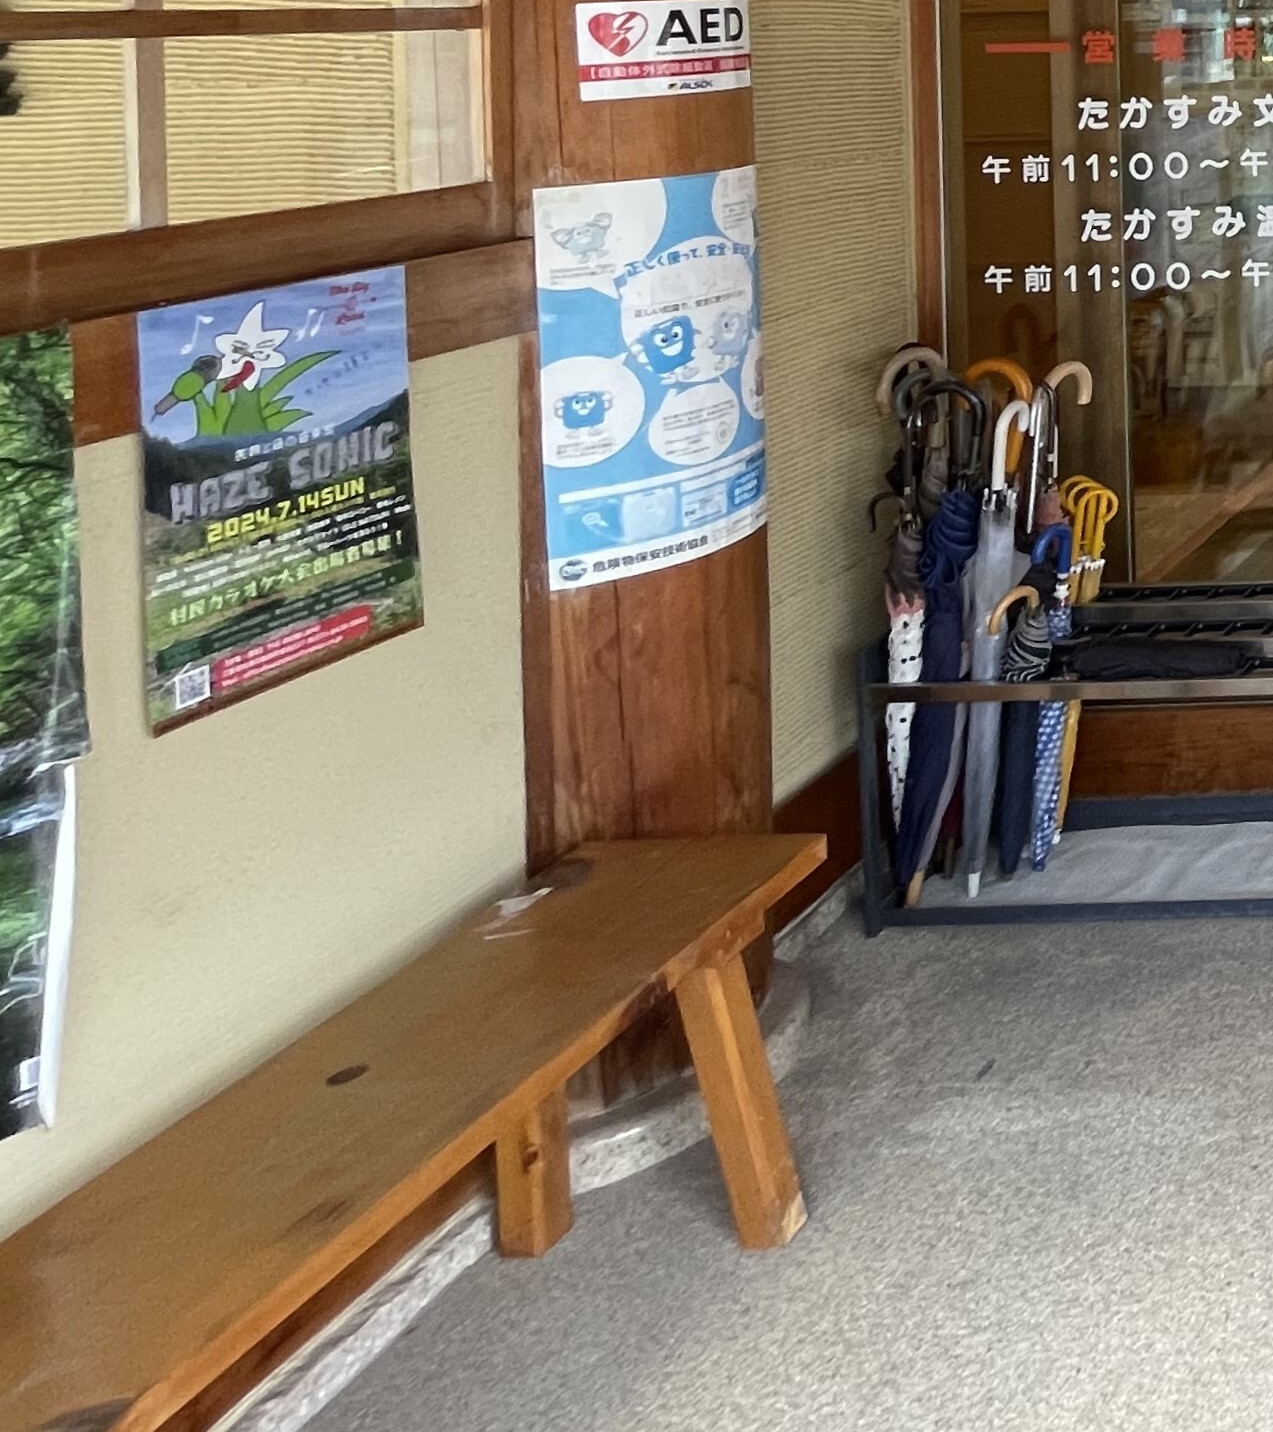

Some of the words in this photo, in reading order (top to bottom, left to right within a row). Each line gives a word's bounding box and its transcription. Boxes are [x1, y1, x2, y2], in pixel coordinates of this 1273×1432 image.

[656, 7, 743, 46] AED
[170, 461, 272, 525] HAZE
[289, 421, 398, 490] SONIC
